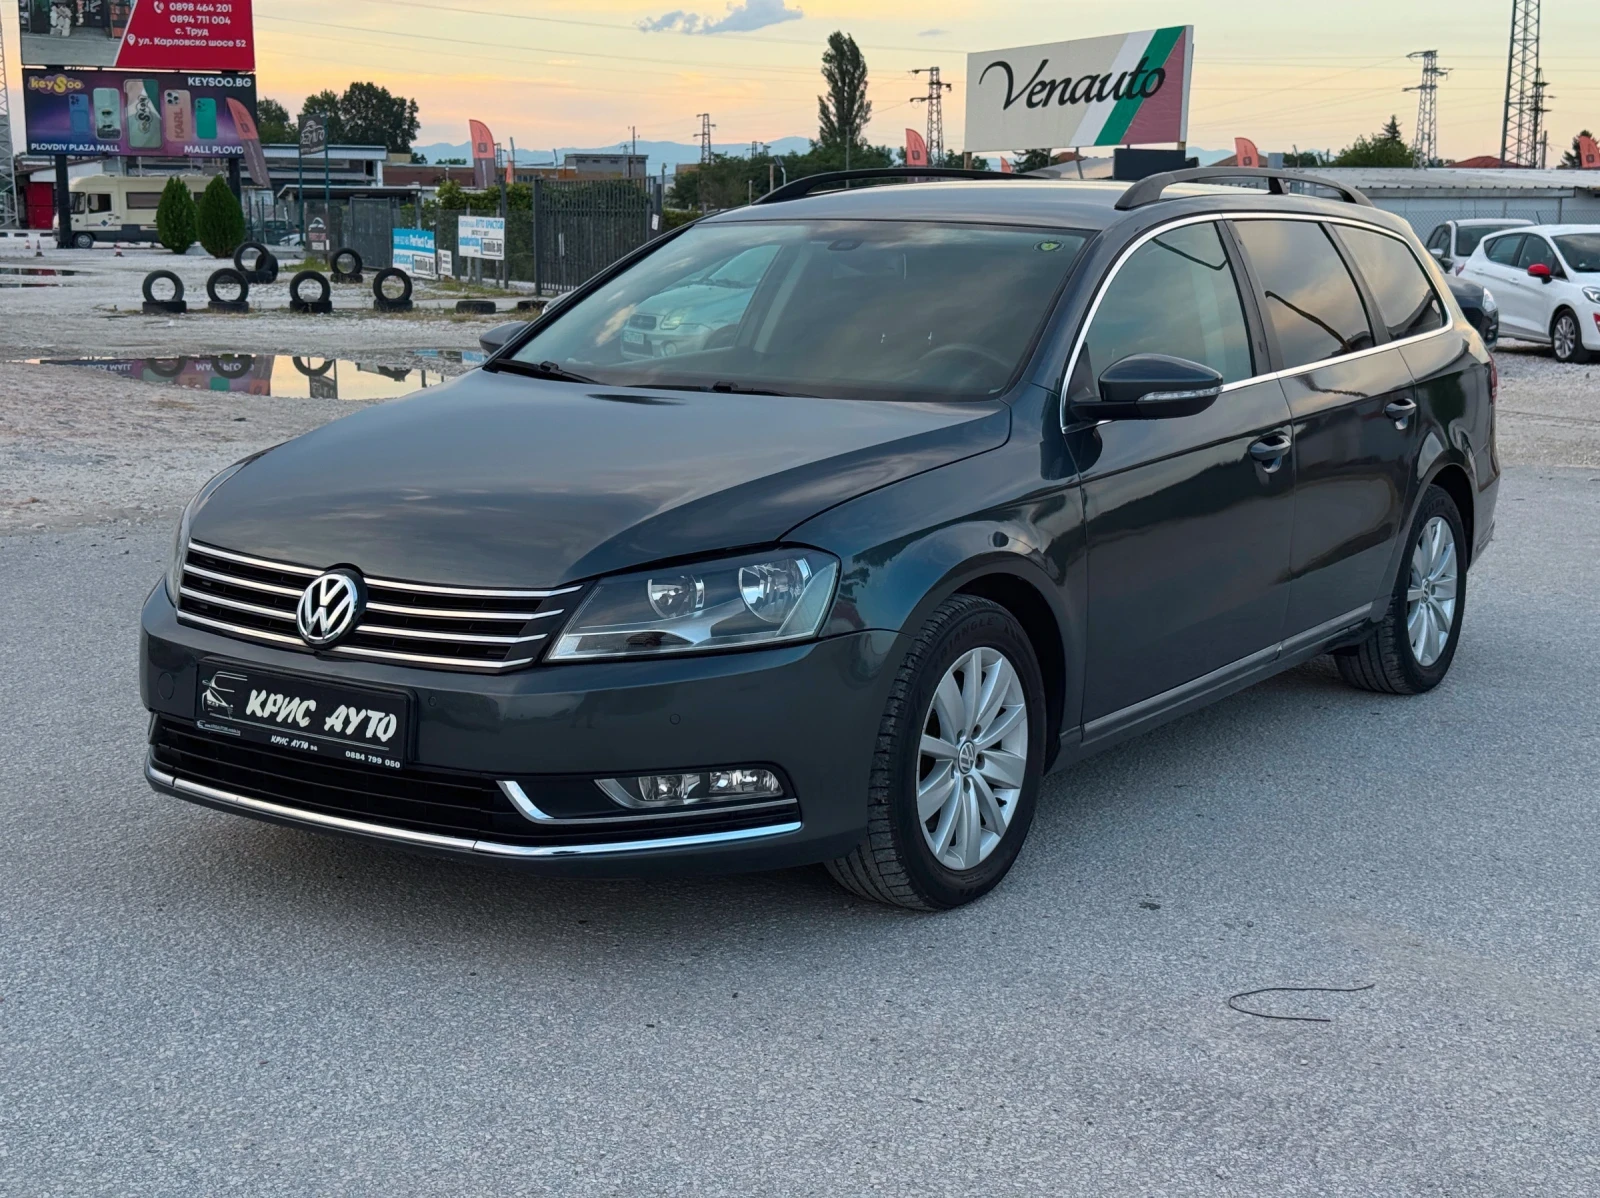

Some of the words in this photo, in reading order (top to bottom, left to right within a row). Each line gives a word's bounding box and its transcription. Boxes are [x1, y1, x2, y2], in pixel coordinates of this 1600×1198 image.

[169, 2, 194, 11] 0898
[196, 3, 214, 12] 464
[216, 4, 232, 13] 201
[169, 15, 195, 24] 0894
[197, 16, 210, 24] 711
[211, 16, 231, 25] 004
[185, 27, 209, 36] Труд
[138, 38, 152, 46] ул.
[154, 37, 207, 47] Карловско
[31, 76, 82, 93] keySoo
[187, 76, 252, 87] KEYSOO.BG
[978, 56, 1166, 111] Venauto
[174, 108, 185, 139] KARL
[31, 143, 68, 151] PLOVDIV
[69, 143, 95, 151] PLAZA
[96, 144, 120, 152] MALL
[184, 145, 211, 154] MALL
[212, 145, 244, 154] PLOVD
[246, 689, 317, 727] КРИС
[324, 705, 397, 742] АУТО
[270, 735, 289, 746] КРИС
[290, 739, 309, 750] АУТО
[345, 750, 365, 761] 0884
[367, 755, 382, 765] 799
